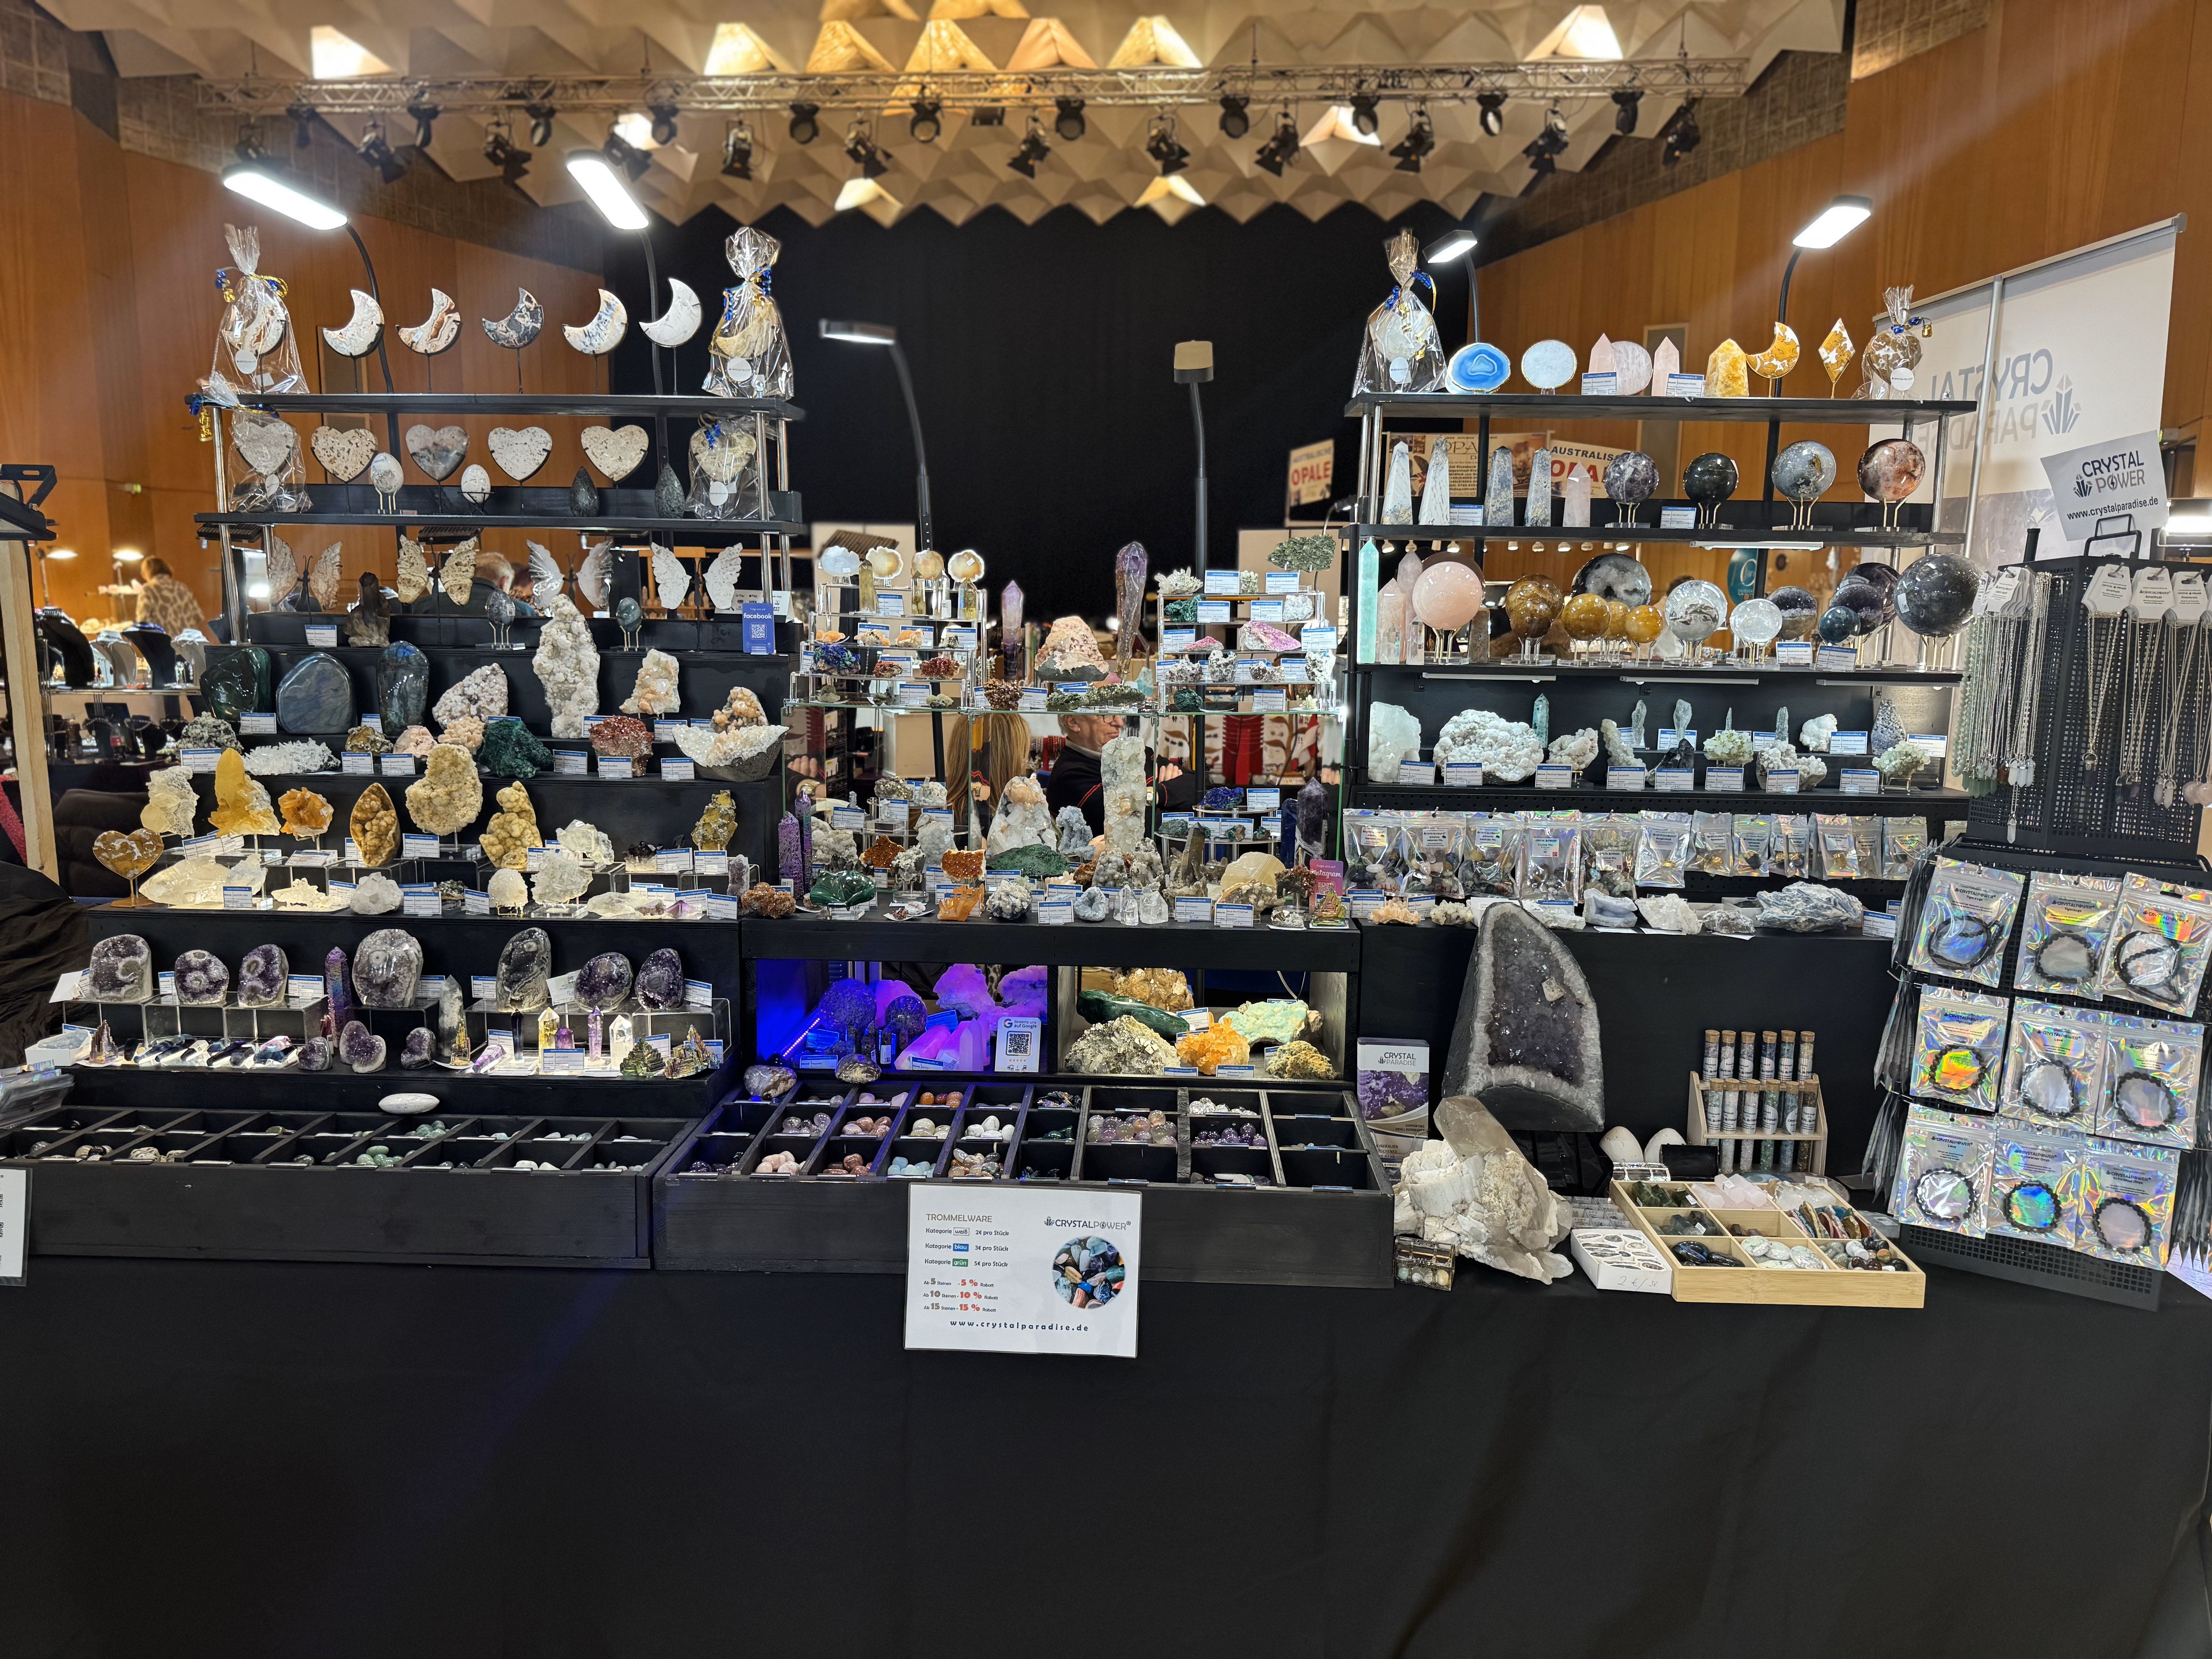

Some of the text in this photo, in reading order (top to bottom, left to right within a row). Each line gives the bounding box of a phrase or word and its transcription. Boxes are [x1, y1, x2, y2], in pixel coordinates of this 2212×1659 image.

[1551, 446, 1614, 461] AUSTRALIS
[2082, 450, 2144, 477] CRYSTAL
[1291, 461, 1331, 486] OPALE
[2095, 469, 2145, 493] POWER
[2067, 496, 2159, 520] www.crystalparadise.de
[1310, 869, 1341, 879] stagram
[1384, 1052, 1417, 1060] CRYSTAL
[926, 1214, 993, 1223] TROMMELWARE
[1617, 1276, 1627, 1286] 2
[950, 1320, 1089, 1332] www.crystalparadise.de
